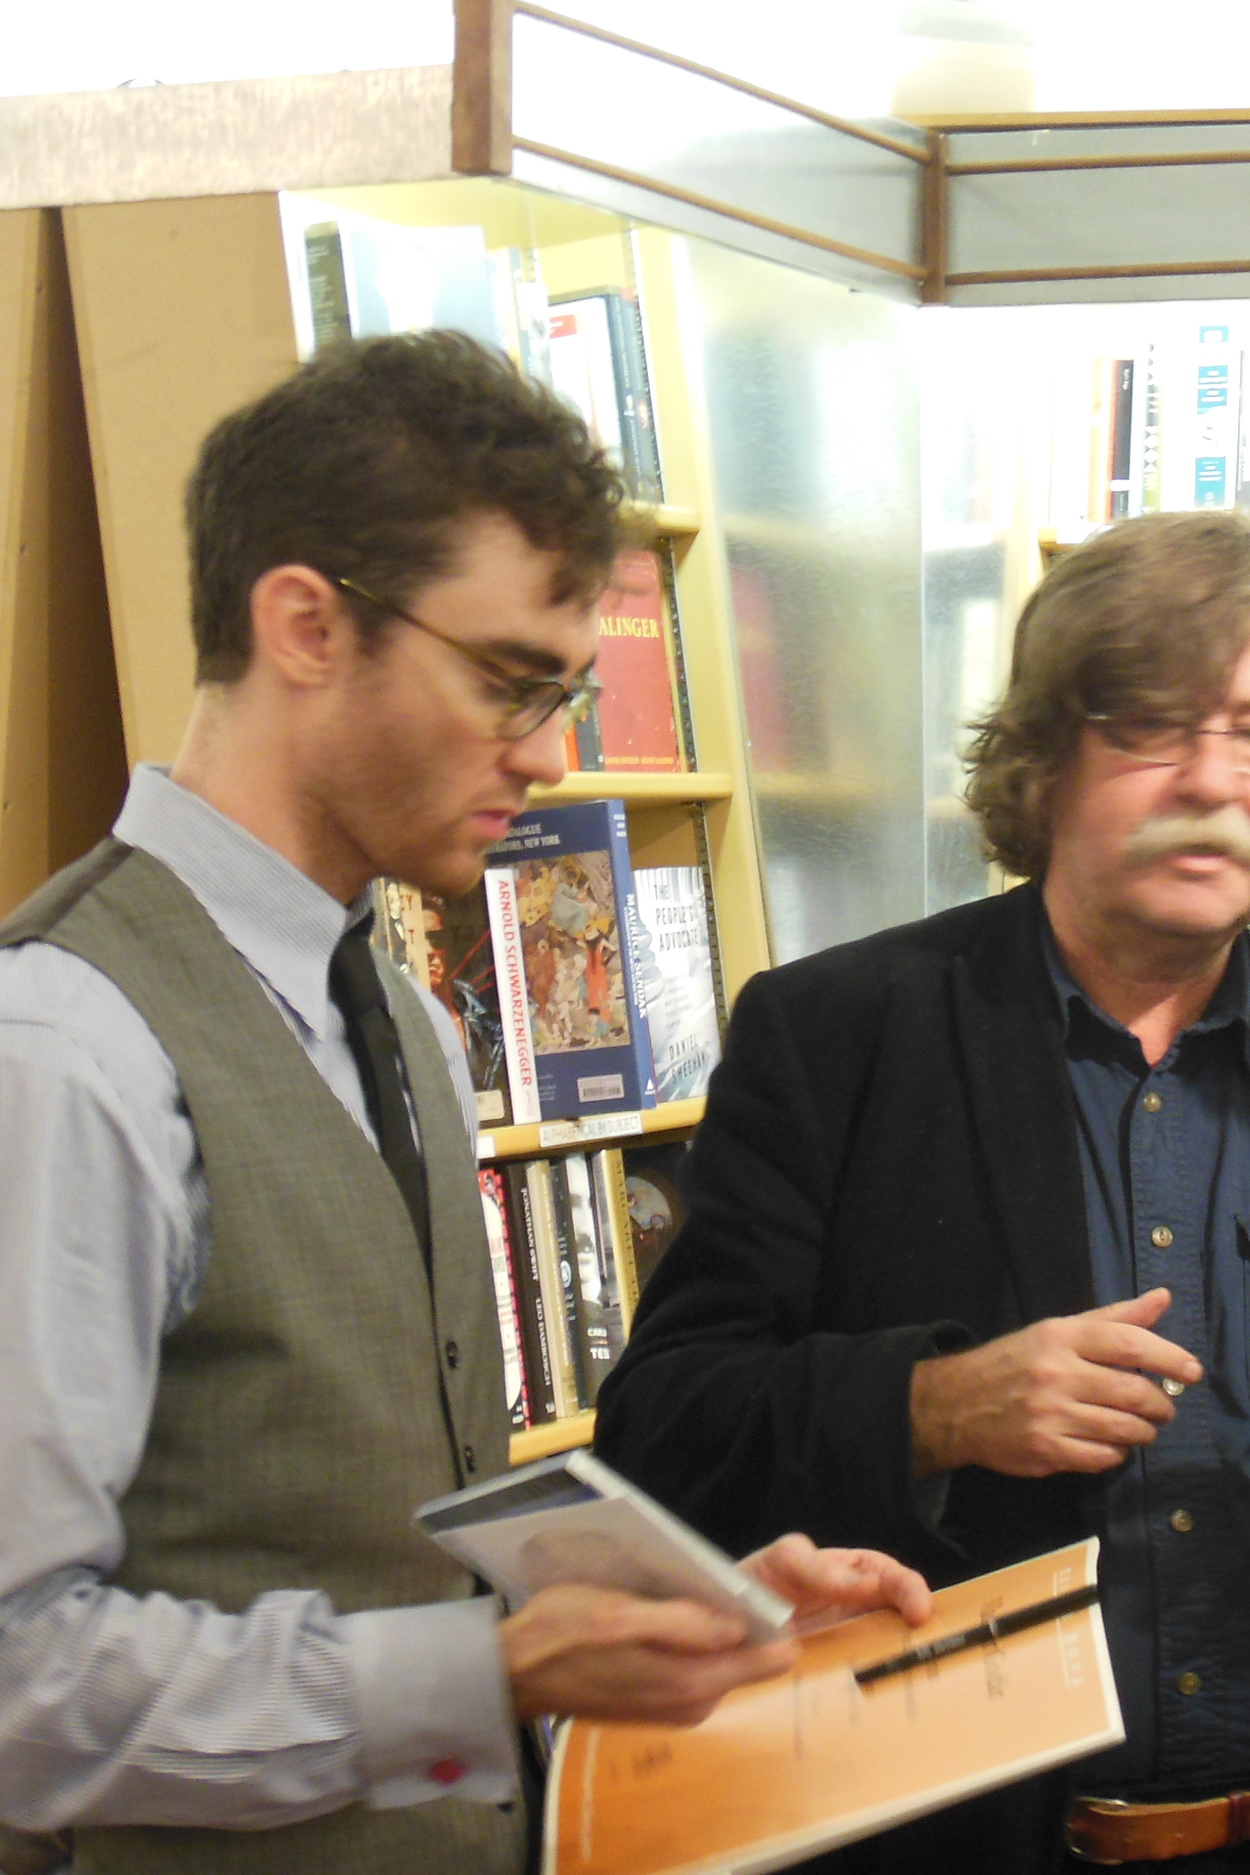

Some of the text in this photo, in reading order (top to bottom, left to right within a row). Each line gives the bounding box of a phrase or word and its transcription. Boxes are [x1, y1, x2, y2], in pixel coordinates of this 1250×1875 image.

[598, 616, 660, 638] ALINGER
[653, 884, 669, 901] THE
[655, 905, 695, 927] PEOPLE'S
[658, 928, 699, 952] ADVOCATE
[626, 893, 641, 960] MAURICE
[634, 962, 648, 1019] SENDAK
[498, 880, 532, 1086] ARNOLD SCHWARZENEGGER
[668, 1034, 698, 1062] DANIEL
[671, 1052, 707, 1085] SHEEHAN
[520, 1187, 540, 1281] JONATHAN SWIFT
[535, 1298, 544, 1320] LEO
